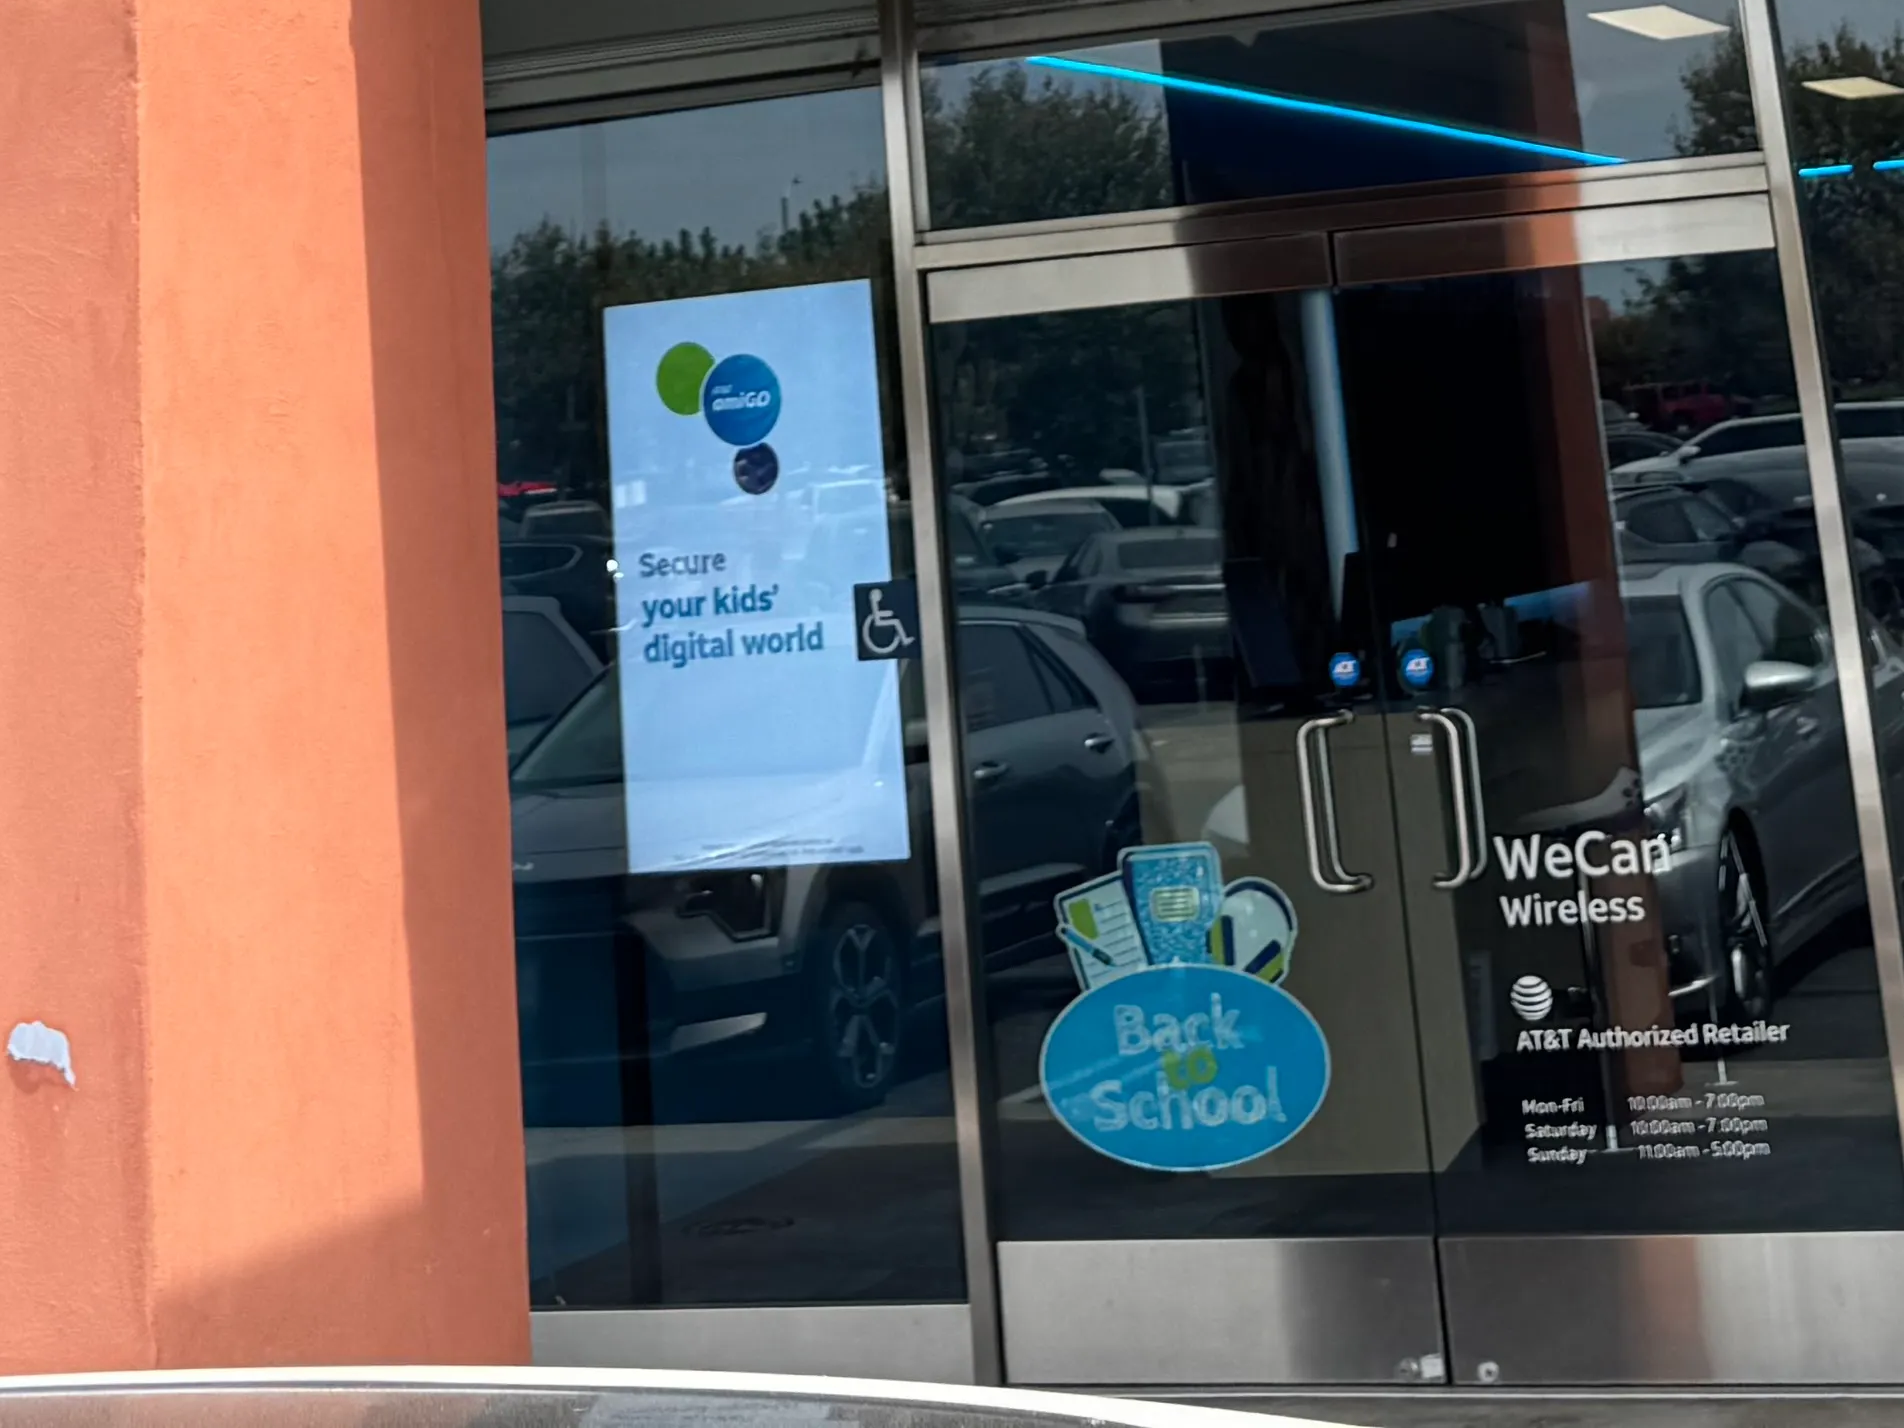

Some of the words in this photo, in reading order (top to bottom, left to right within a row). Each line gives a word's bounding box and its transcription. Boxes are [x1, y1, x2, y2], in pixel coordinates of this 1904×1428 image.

[638, 551, 727, 578] Secure
[641, 595, 707, 629] your
[643, 628, 735, 669] digital
[740, 621, 824, 656] world
[1492, 829, 1672, 882] WeCan
[1499, 889, 1646, 928] Wireless
[1112, 992, 1245, 1056] Back
[1516, 1028, 1573, 1052] AT&T
[1576, 1023, 1699, 1050] Authorized
[1702, 1019, 1791, 1045] Retailer
[1161, 1043, 1218, 1090] to
[1092, 1065, 1288, 1133] School
[1521, 1096, 1586, 1115] Mon-Fri
[1524, 1120, 1598, 1142] Saturday
[1527, 1145, 1588, 1166] Sunday
